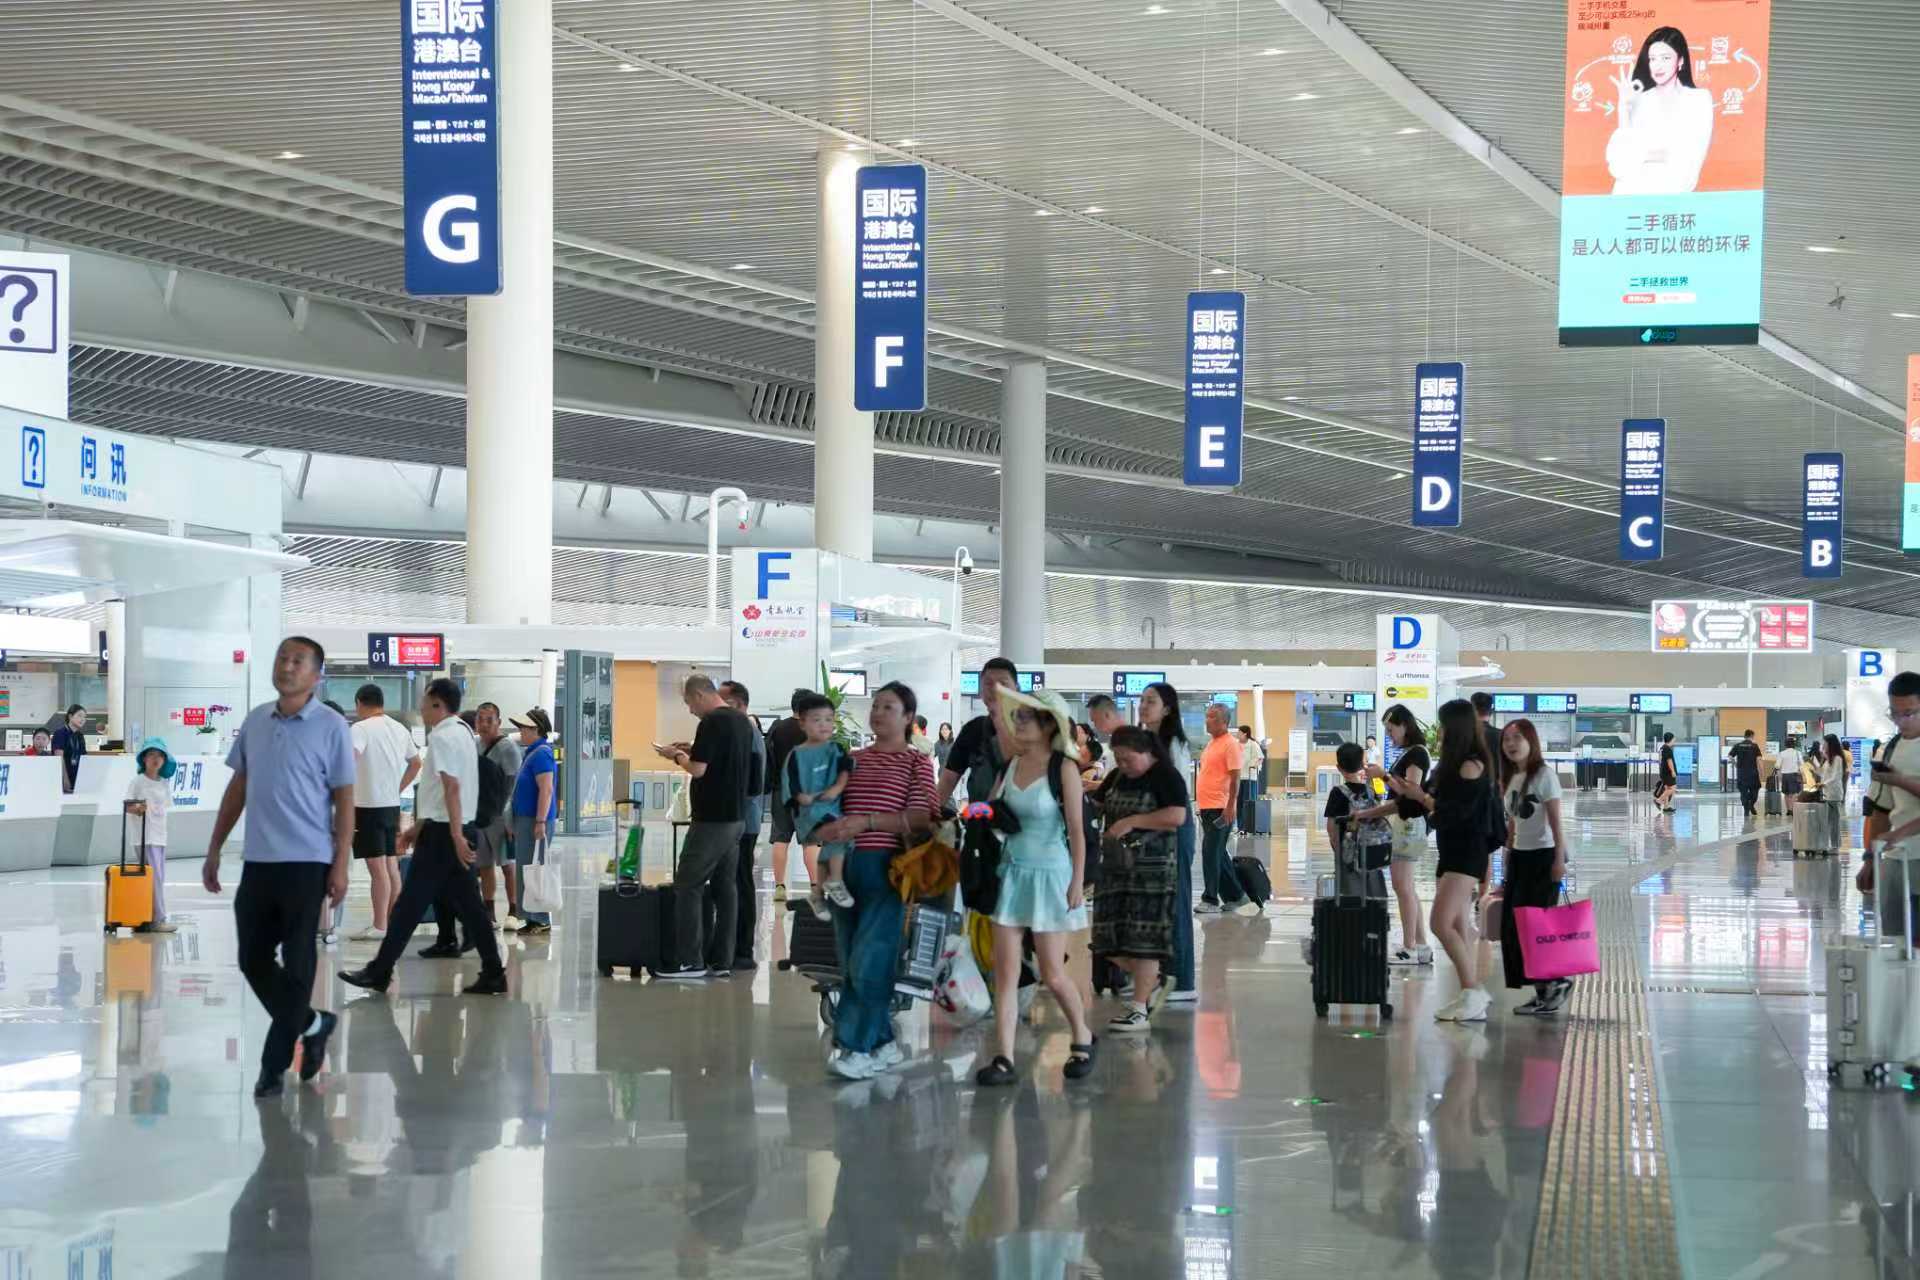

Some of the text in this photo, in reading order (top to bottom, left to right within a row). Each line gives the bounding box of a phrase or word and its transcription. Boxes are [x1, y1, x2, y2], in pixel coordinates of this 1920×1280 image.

[411, 0, 485, 34] 国际
[413, 38, 482, 63] 港澳台
[412, 68, 491, 80] International &
[412, 81, 475, 95] Hong Kong/
[413, 93, 488, 104] Macao/Taiwan
[862, 189, 918, 218] 国际
[423, 194, 480, 264] G
[864, 219, 916, 240] 港澳台
[1626, 213, 1697, 232] 二手循环
[1572, 234, 1751, 256] 是人人都可以做的环保
[1630, 276, 1689, 287] 二手拯救世界
[1193, 310, 1238, 333] 国际
[875, 336, 904, 387] F
[1420, 378, 1458, 397] 国际
[1199, 426, 1225, 468] E
[1626, 431, 1660, 449] 国际
[81, 436, 127, 485] 问讯
[81, 484, 127, 502] INFORMATION
[1421, 476, 1452, 512] D
[1628, 516, 1654, 548] C
[1811, 539, 1833, 567] B
[757, 552, 792, 600] F
[375, 639, 382, 648] F
[1393, 616, 1422, 650] D
[372, 651, 386, 663] 01
[1859, 651, 1883, 677] B
[1115, 684, 1126, 692] 01
